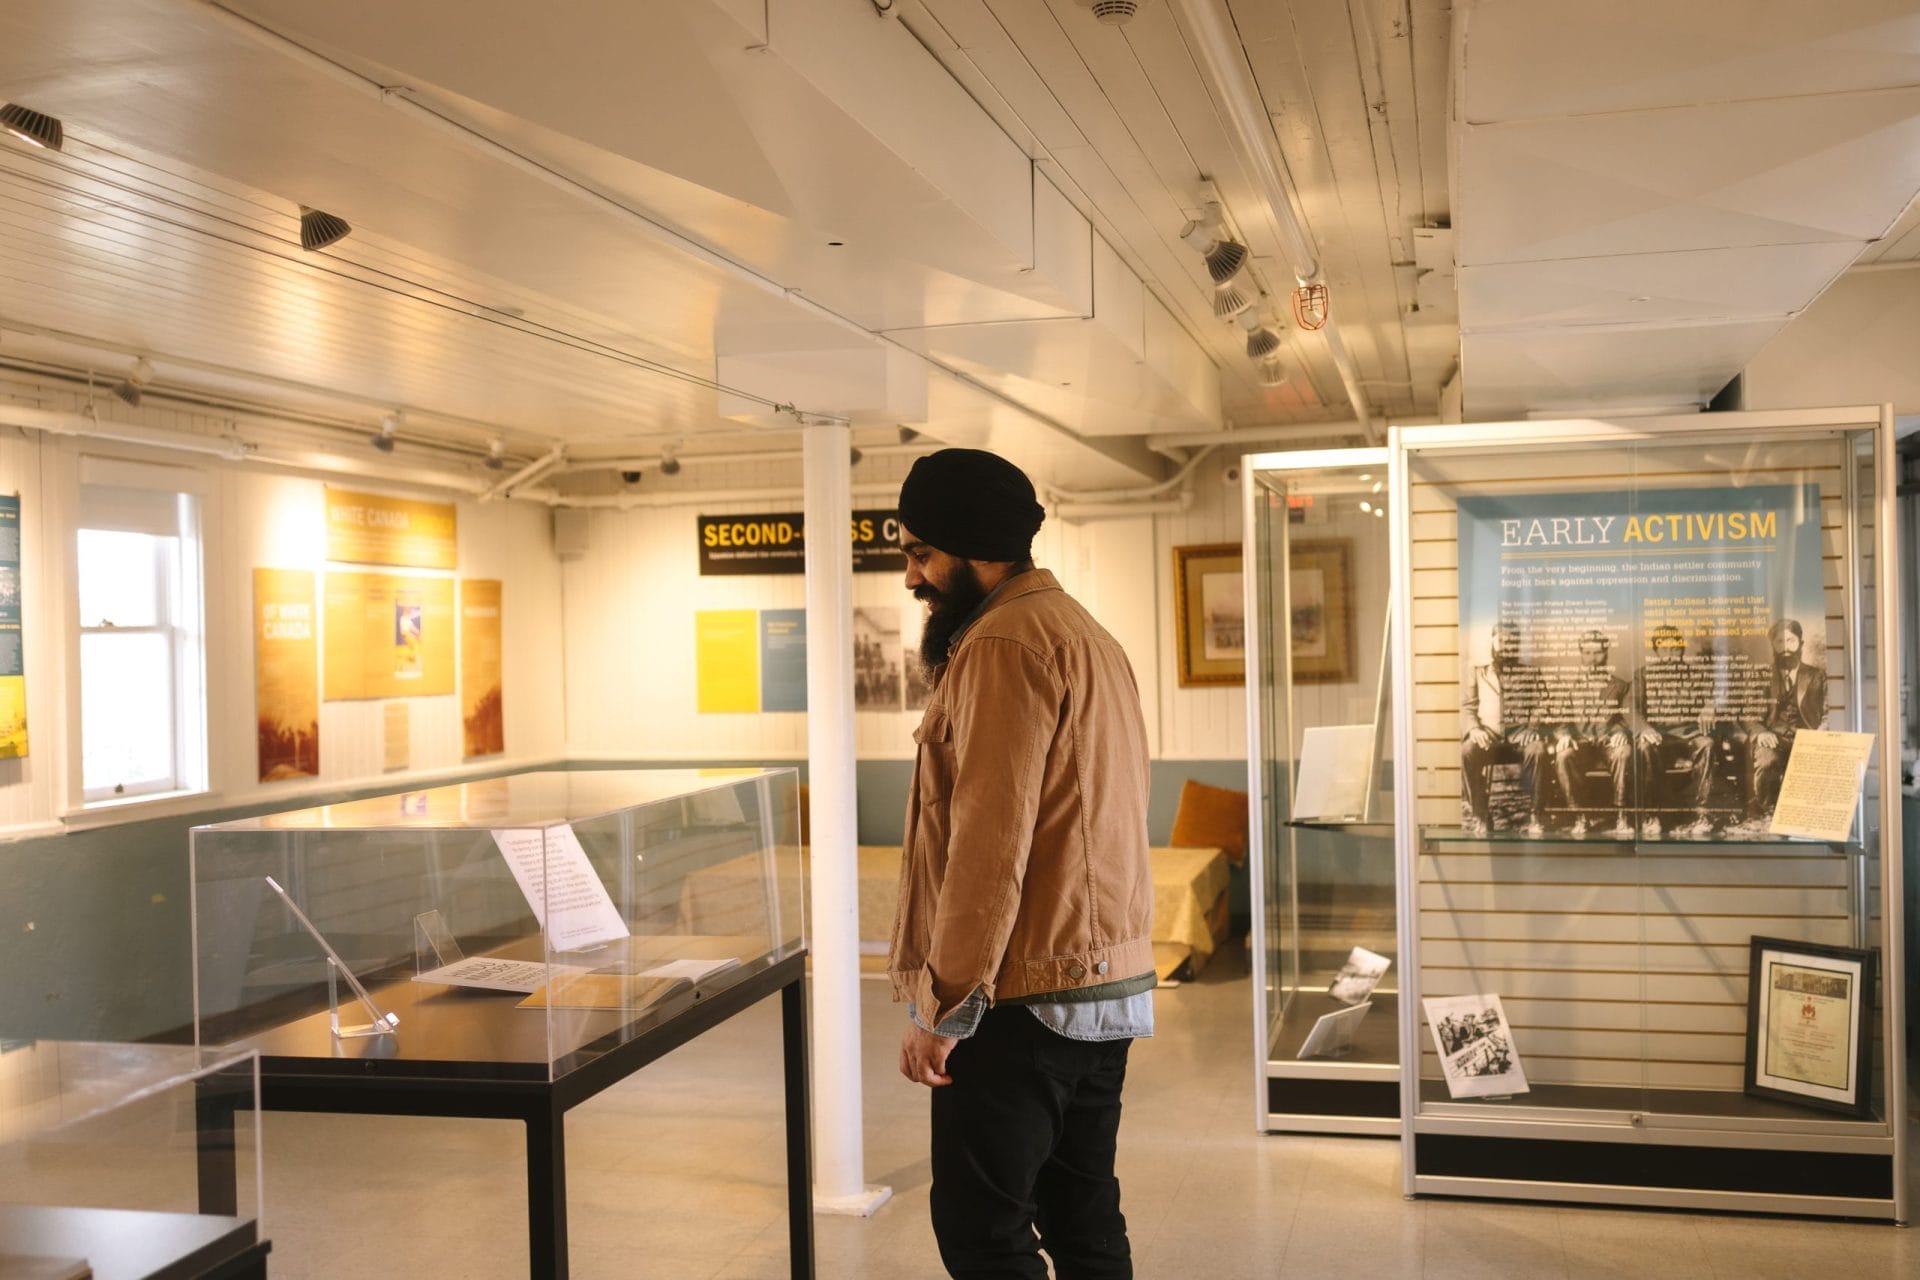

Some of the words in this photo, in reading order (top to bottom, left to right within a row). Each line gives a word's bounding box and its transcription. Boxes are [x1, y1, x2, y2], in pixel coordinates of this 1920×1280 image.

[1501, 515, 1616, 547] EARLY
[1623, 511, 1777, 543] ACTIVISM
[1502, 566, 1526, 575] From
[1527, 565, 1543, 574] the
[1545, 566, 1566, 575] very
[1622, 562, 1638, 572] the
[1640, 561, 1671, 571] Indian
[1673, 560, 1704, 570] settler
[1707, 559, 1761, 569] community
[1535, 577, 1557, 586] back
[1559, 576, 1593, 587] against
[1596, 574, 1648, 586] oppression
[1650, 574, 1669, 584] and
[1671, 573, 1744, 583] discrimination.
[1674, 597, 1706, 606] Indians
[1708, 596, 1744, 605] believed
[1747, 595, 1765, 604] that
